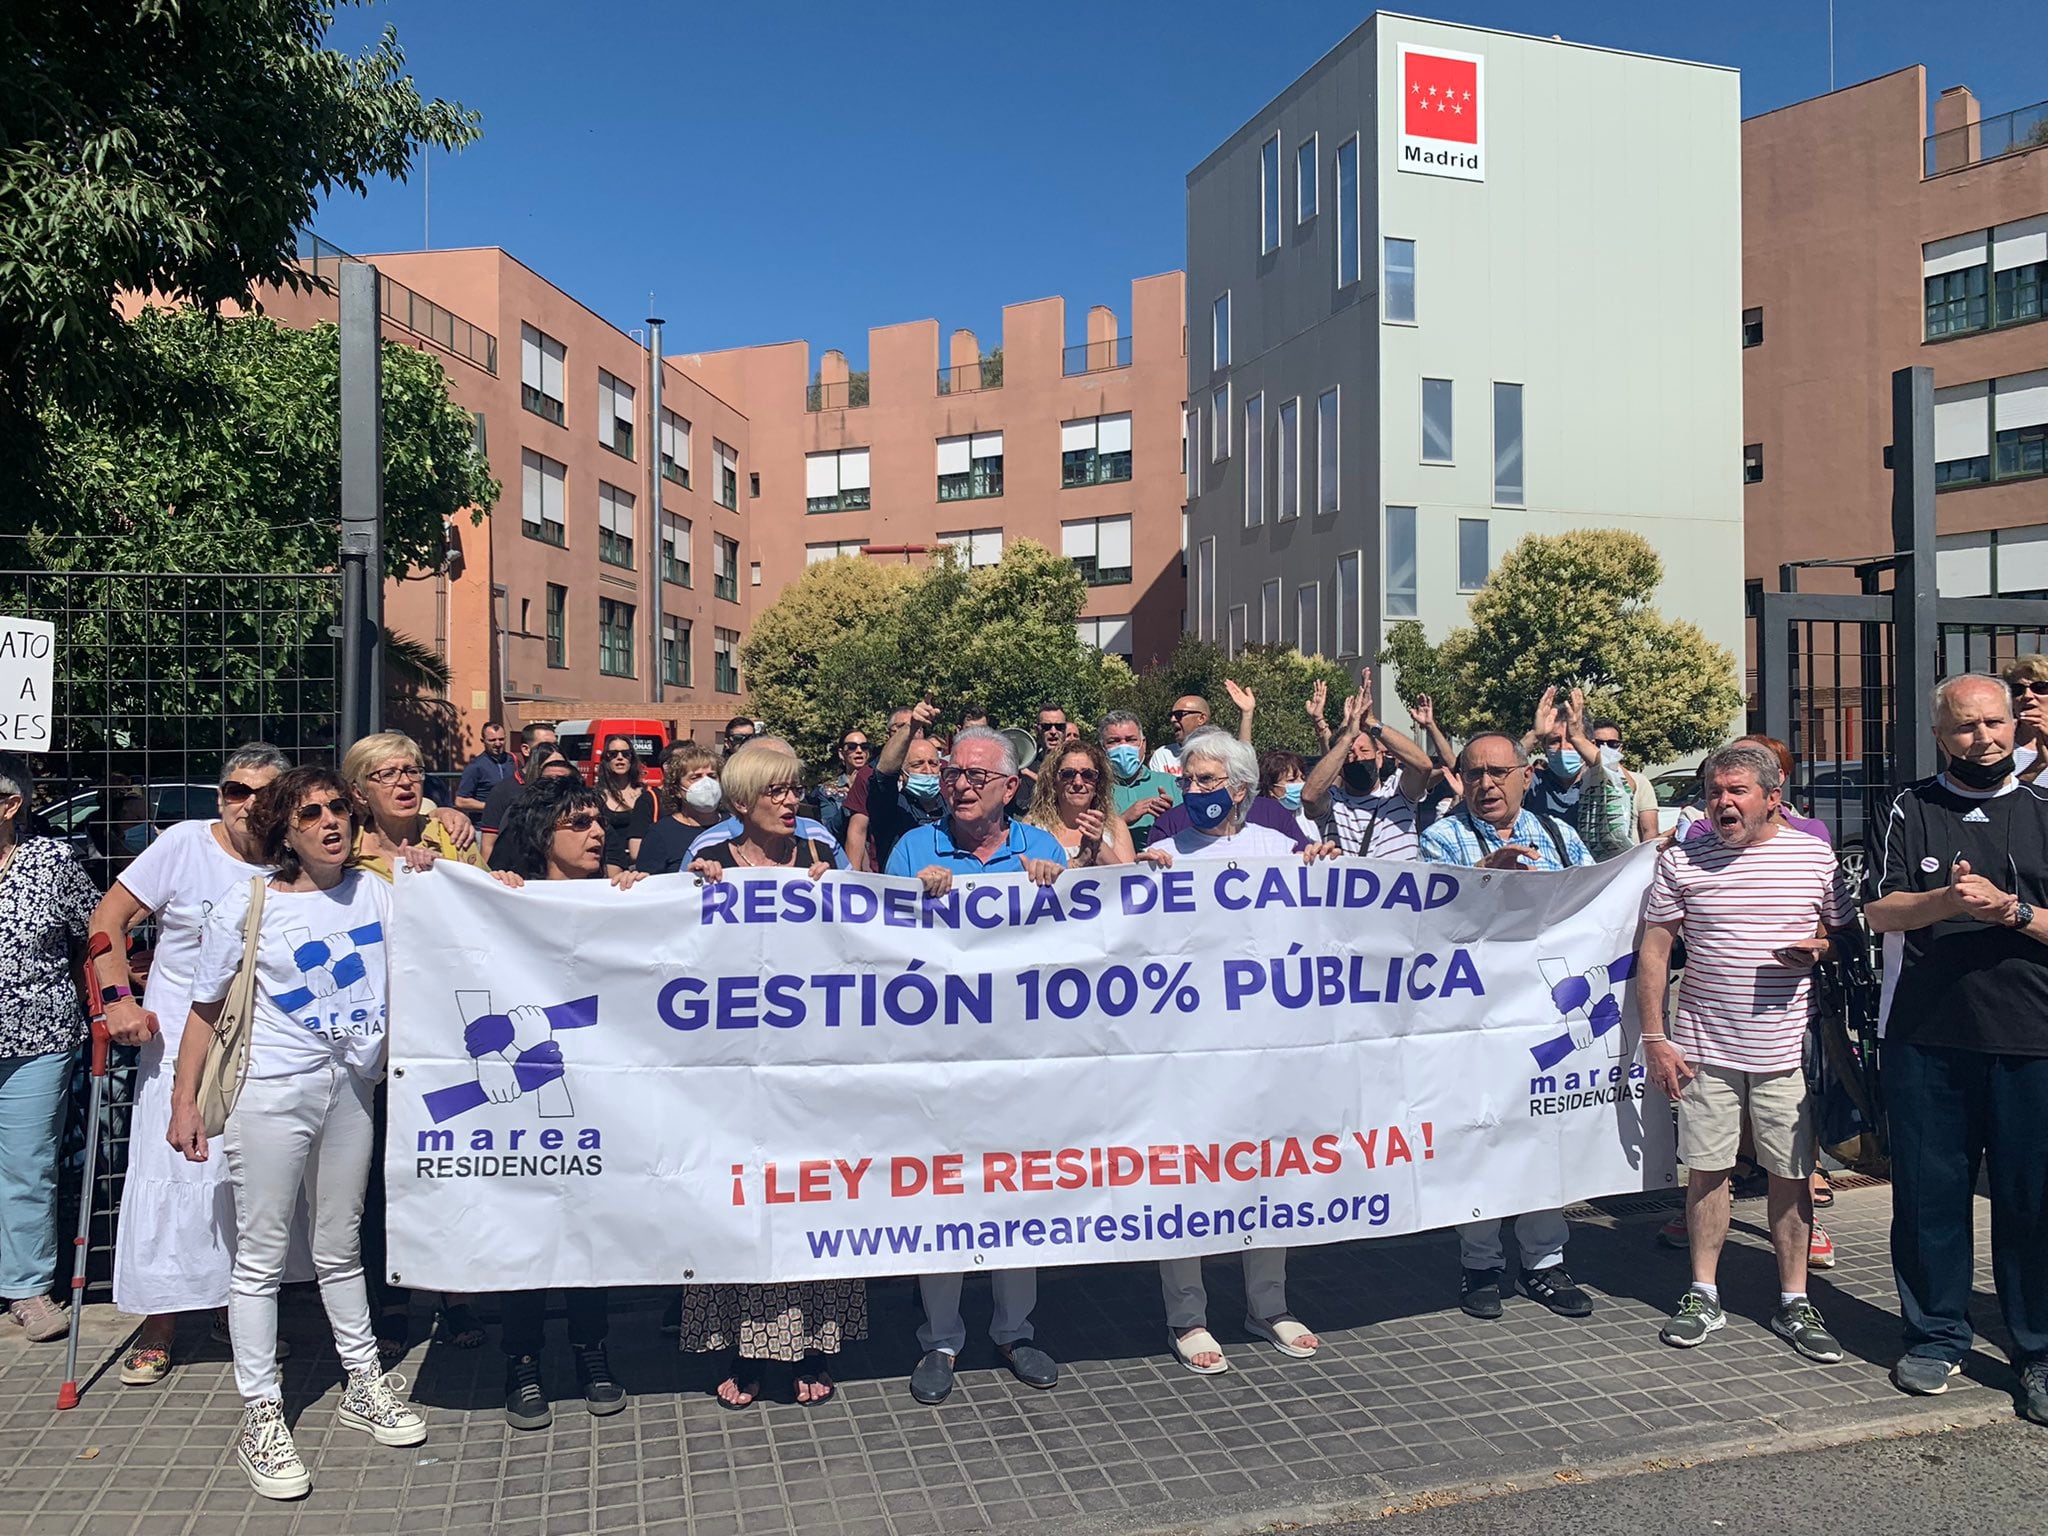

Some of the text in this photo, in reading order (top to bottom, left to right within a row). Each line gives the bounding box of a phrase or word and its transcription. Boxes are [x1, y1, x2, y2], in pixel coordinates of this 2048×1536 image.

[1405, 145, 1478, 169] Madrid
[19, 677, 36, 701] A
[701, 866, 1460, 929] RESIDENCIAS DE CALIDAD
[657, 942, 1486, 1031] GESTIÓN 100% PÚBLICA
[1530, 1062, 1645, 1095] marea
[1530, 1082, 1645, 1117] RESIDENCIAS
[417, 1128, 601, 1151] marea
[416, 1154, 602, 1178] RESIDENCIAS
[732, 1122, 1434, 1206] ¡LEY DE RESIDENCIAS YA!
[806, 1192, 1390, 1259] www.marearesidencias.org
